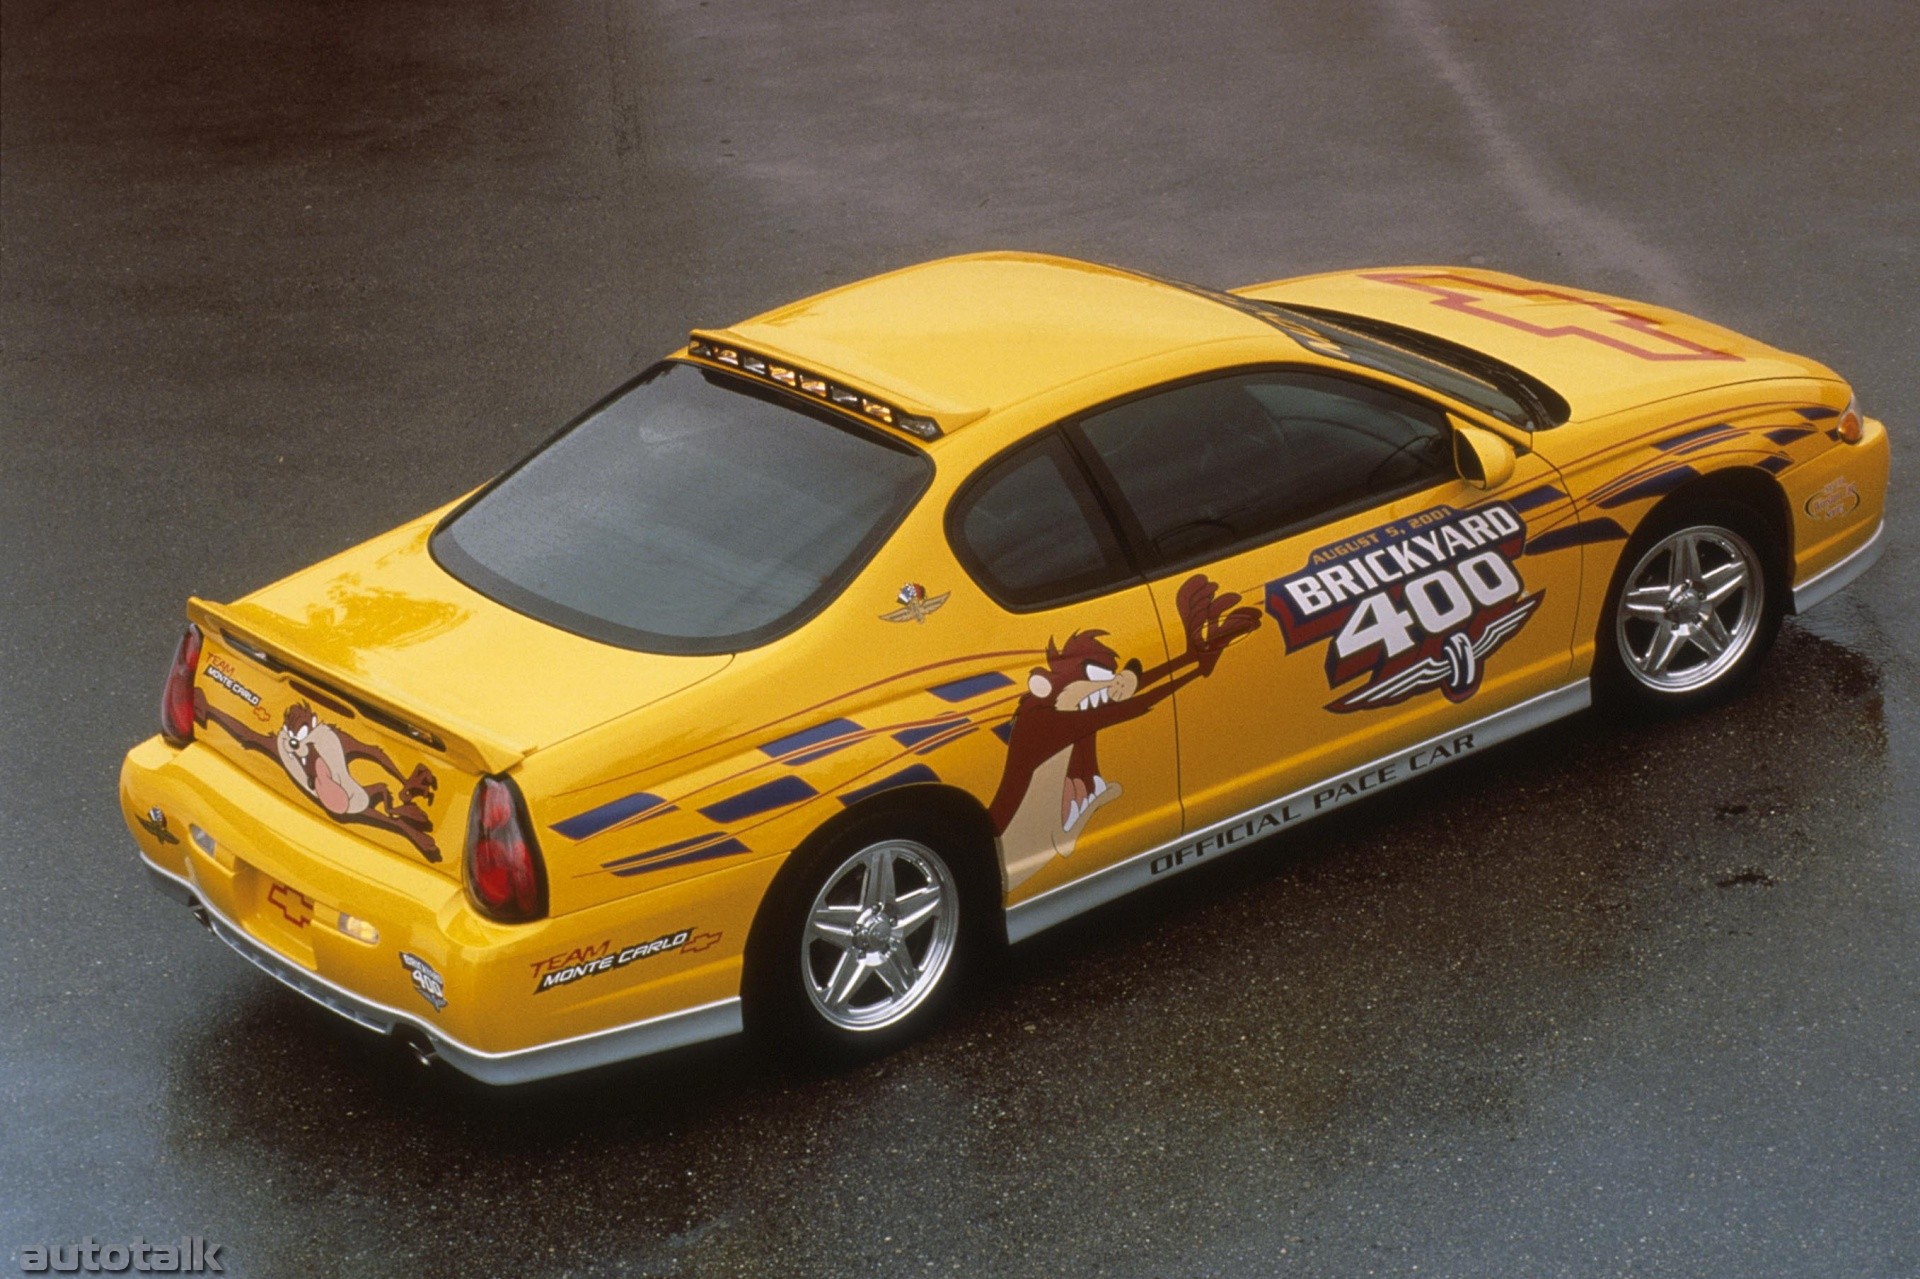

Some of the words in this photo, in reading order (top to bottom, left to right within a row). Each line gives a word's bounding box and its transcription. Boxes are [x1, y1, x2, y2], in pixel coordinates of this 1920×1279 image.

[1284, 506, 1520, 615] BRICKYARD
[1312, 534, 1380, 565] AUGUST
[1411, 508, 1452, 530] 2001
[1336, 551, 1522, 659] 400
[205, 652, 236, 676] TEAM
[207, 667, 232, 689] MONTE
[231, 683, 259, 705] CARLO
[1150, 806, 1301, 876] OFFICIAL
[1313, 764, 1398, 810] PACE
[1409, 733, 1476, 772] CAR
[530, 940, 611, 979] TEAM
[543, 957, 613, 988] MONTE
[618, 931, 689, 964] CARLO
